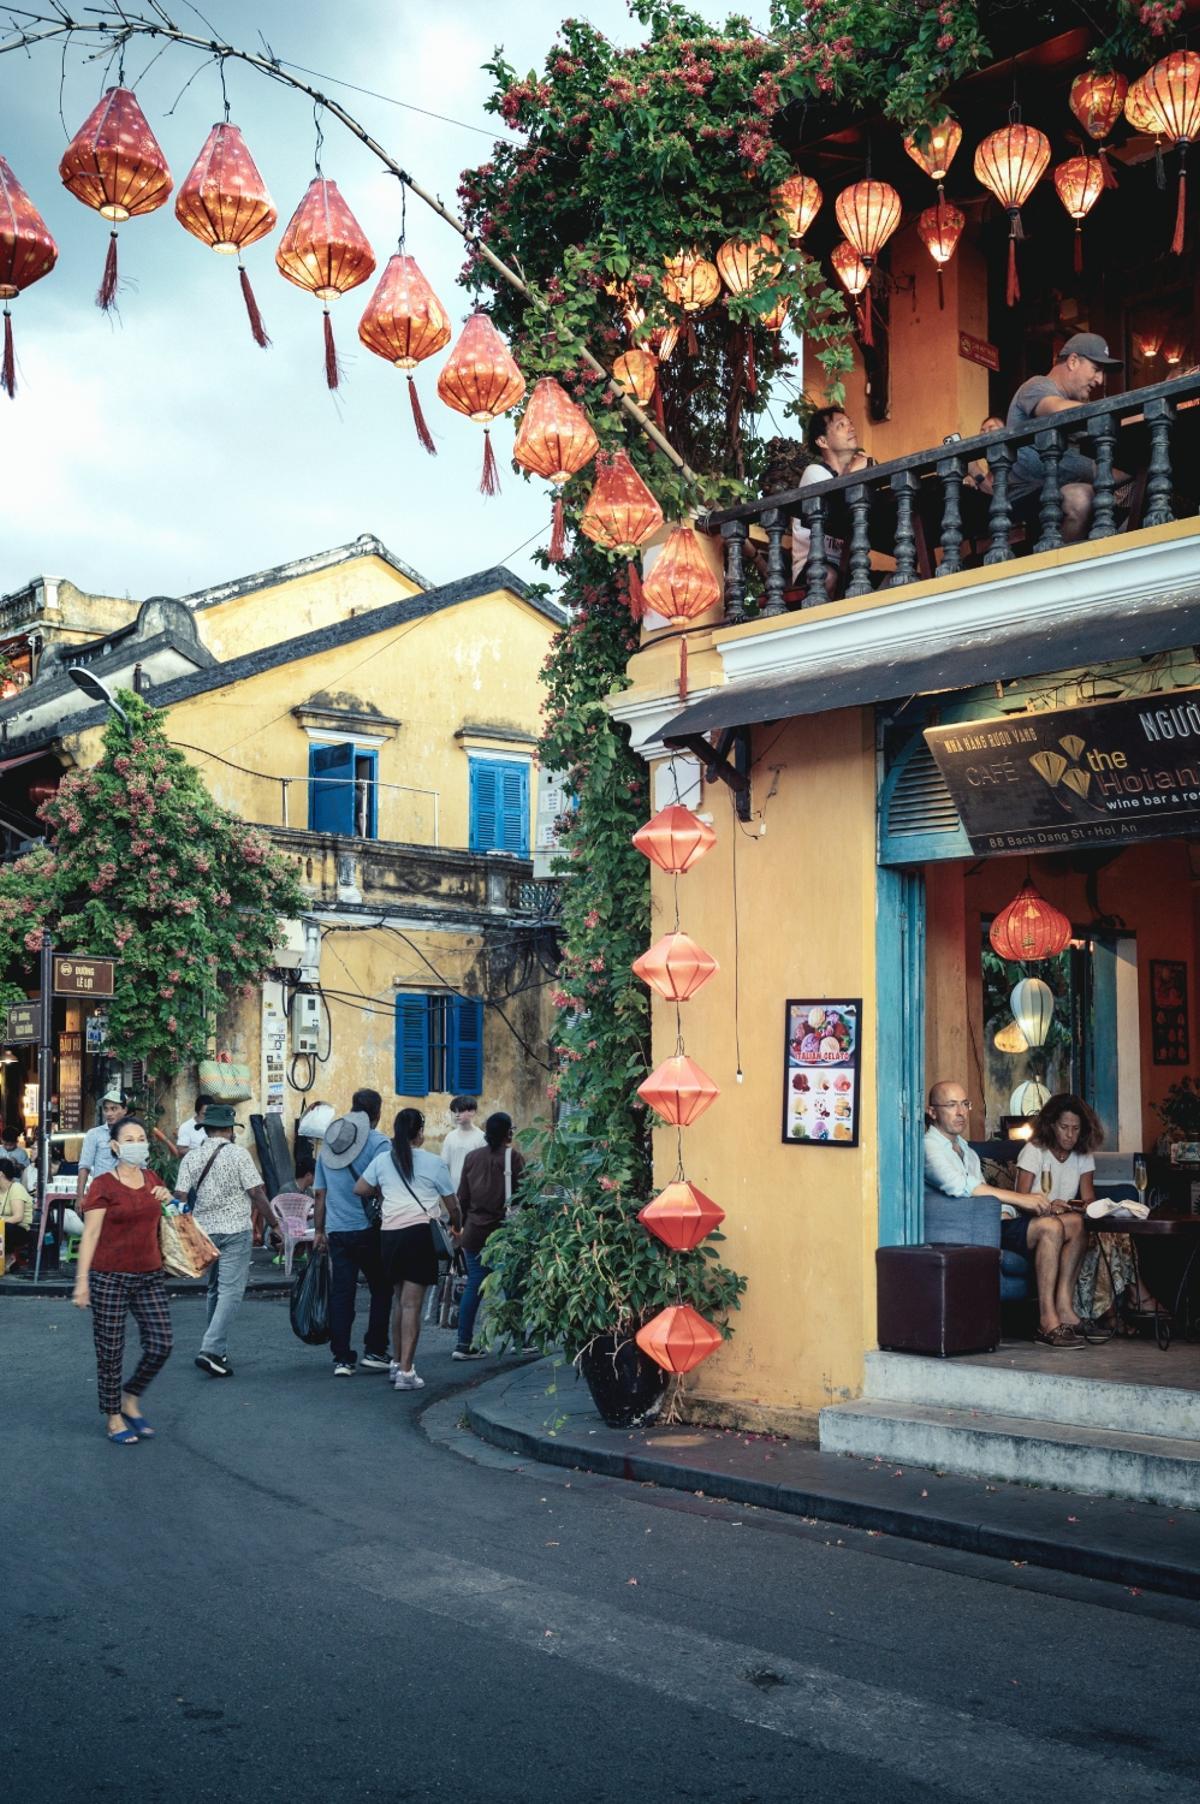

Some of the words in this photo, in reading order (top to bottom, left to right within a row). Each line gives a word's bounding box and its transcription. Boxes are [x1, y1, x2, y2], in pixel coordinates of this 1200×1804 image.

[1011, 727, 1038, 743] VANG
[965, 756, 1020, 786] CAFÉ
[1086, 748, 1128, 772] the
[1096, 761, 1200, 796] Hoian
[1106, 798, 1139, 810] wine
[1142, 795, 1167, 806] bar
[1171, 793, 1180, 803] &
[1182, 791, 1200, 801] re
[1007, 833, 1036, 847] Bach
[1038, 831, 1070, 843] Dang
[1071, 828, 1085, 839] St
[1093, 825, 1117, 837] Hoi
[1120, 823, 1138, 834] An
